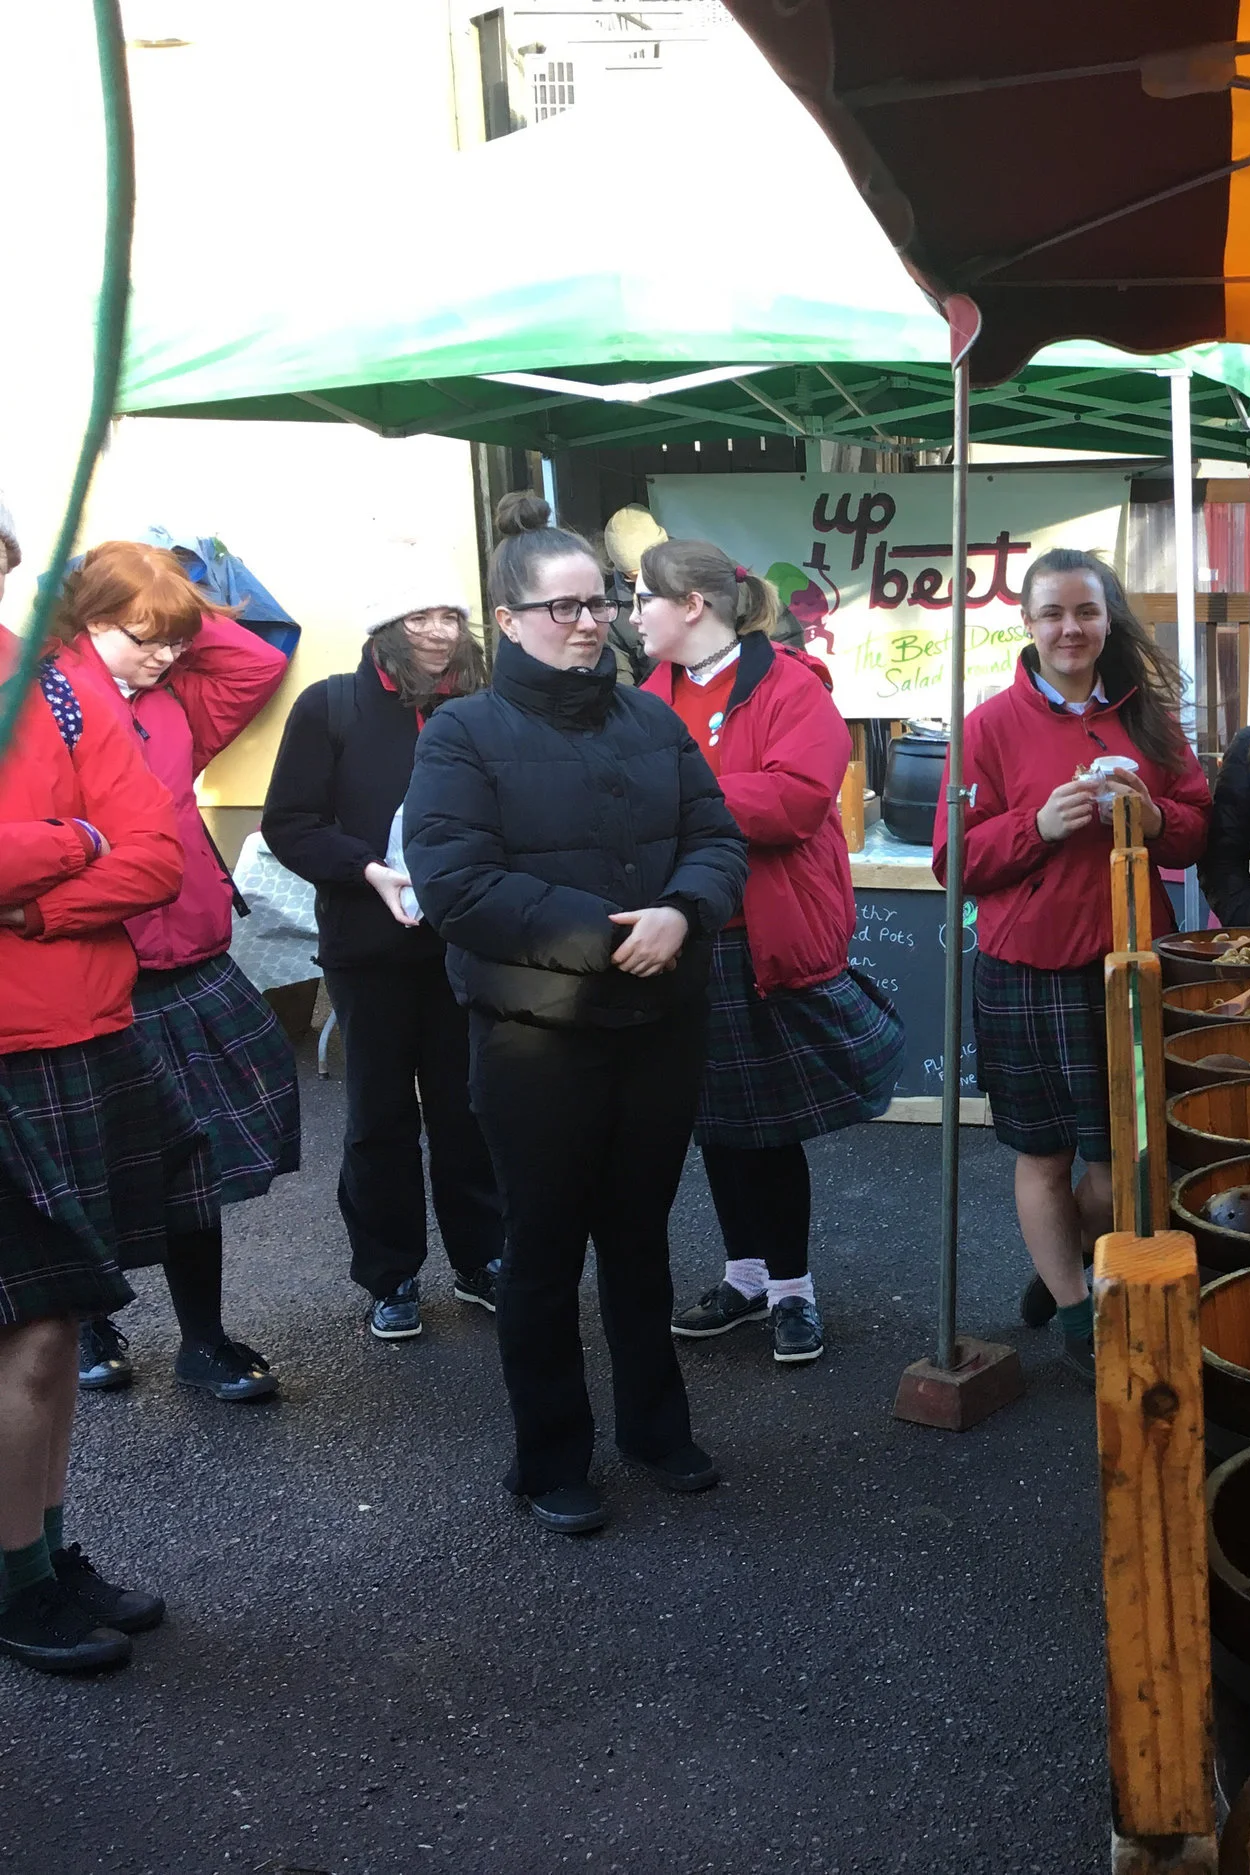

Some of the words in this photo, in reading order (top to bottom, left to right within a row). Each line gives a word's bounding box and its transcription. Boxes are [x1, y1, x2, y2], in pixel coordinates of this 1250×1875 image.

[812, 492, 896, 570] up
[869, 531, 1031, 609] beet
[891, 629, 953, 663] Best
[965, 625, 1029, 652] Dress
[877, 664, 944, 698] Salad
[879, 927, 914, 947] Pots
